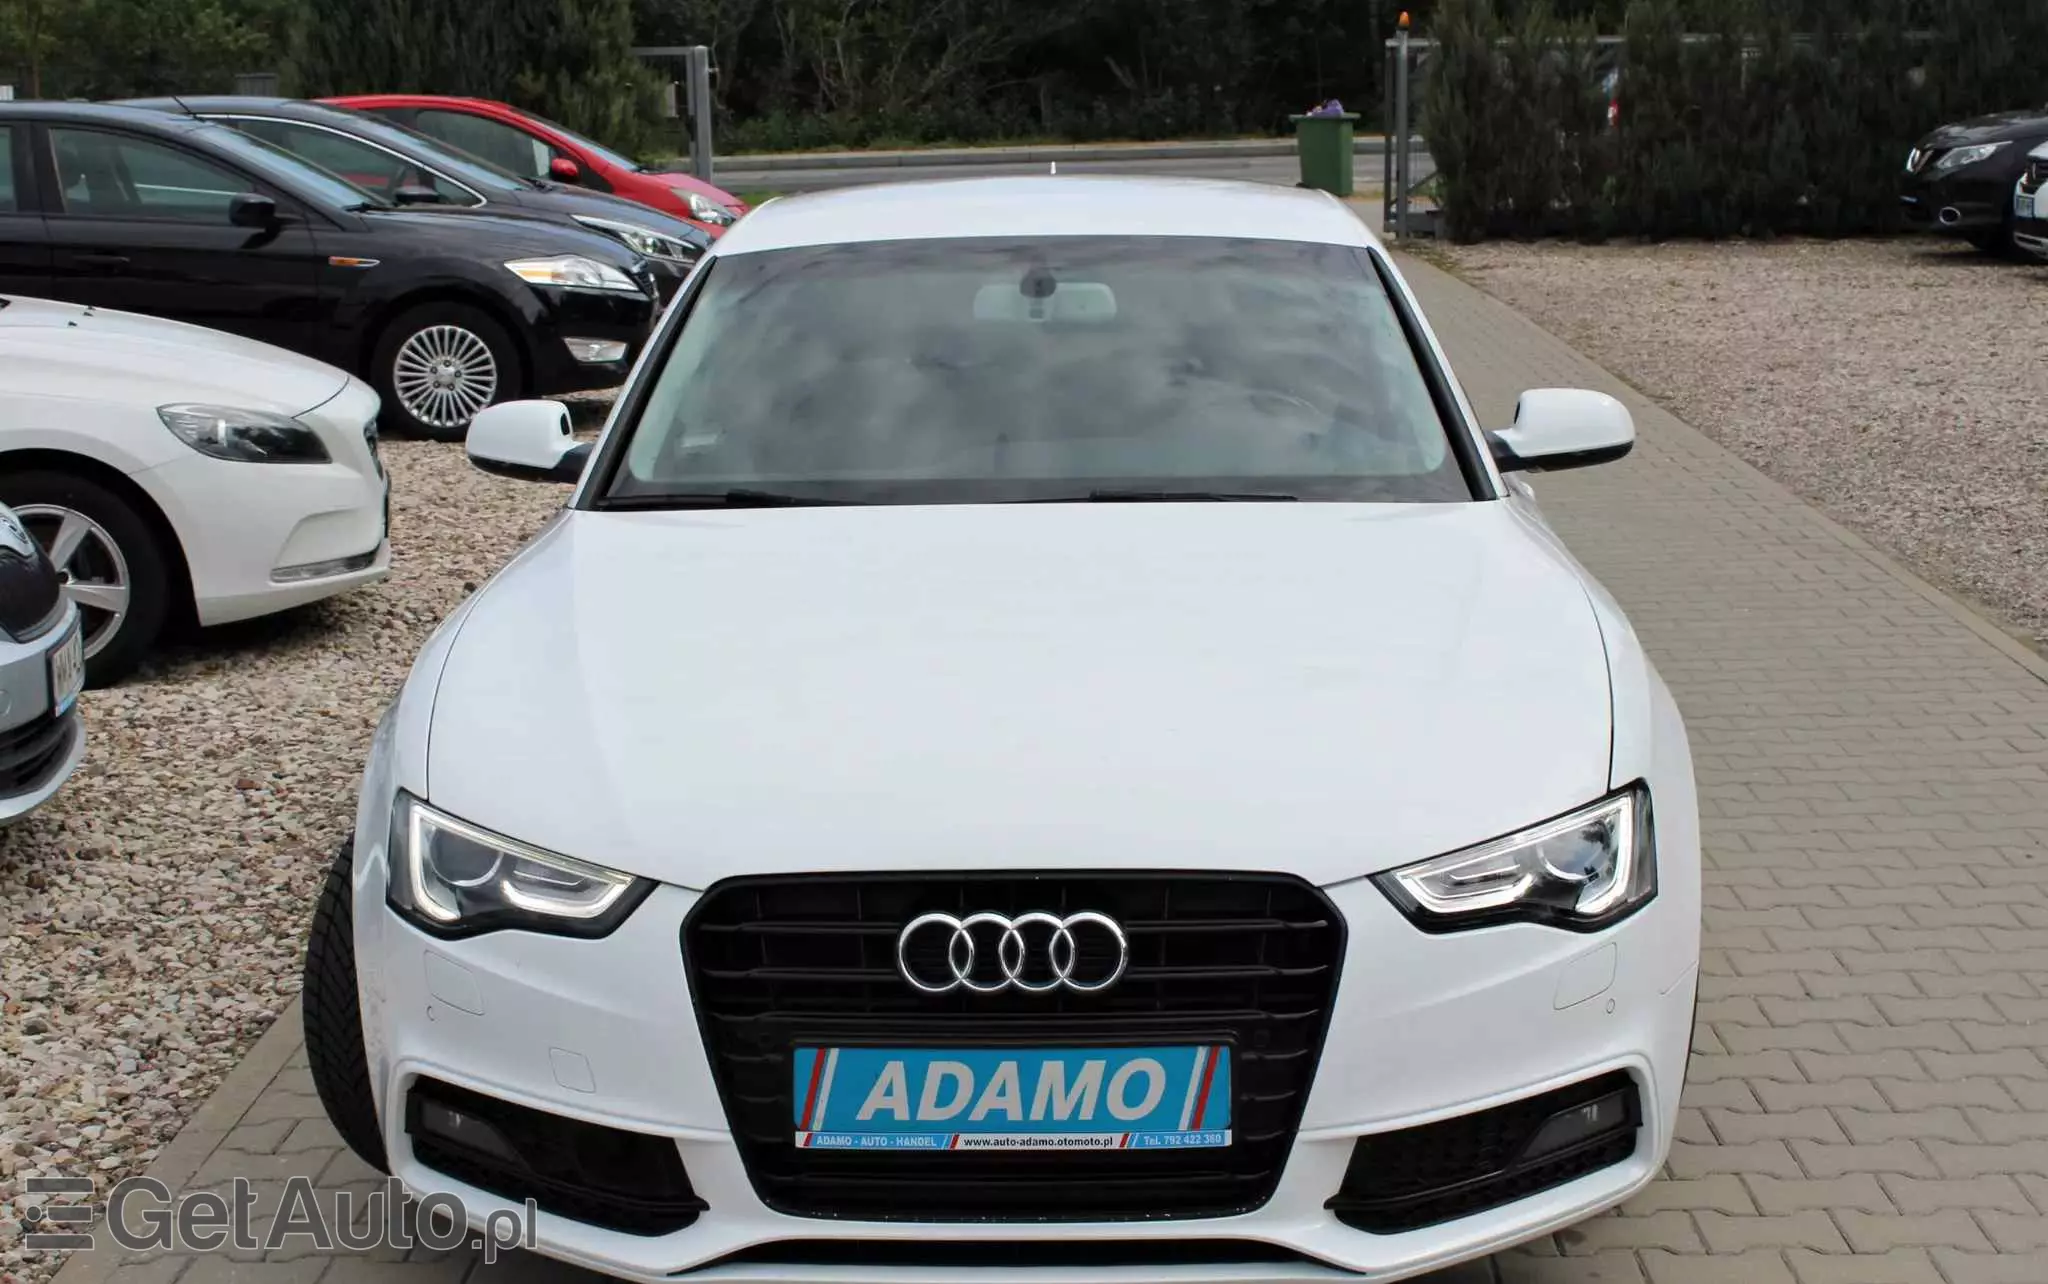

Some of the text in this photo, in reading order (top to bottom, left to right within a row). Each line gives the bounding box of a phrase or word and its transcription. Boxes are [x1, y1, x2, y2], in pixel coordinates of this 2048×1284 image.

[856, 1058, 1167, 1121] ADAMO
[816, 1136, 852, 1146] ADAMO
[860, 1136, 888, 1146] AUTO
[896, 1136, 937, 1147] HANDEL
[964, 1136, 1113, 1148] www.auto-adamo.otomoto.pl
[1164, 1135, 1182, 1145] 792
[1184, 1134, 1201, 1145] 422
